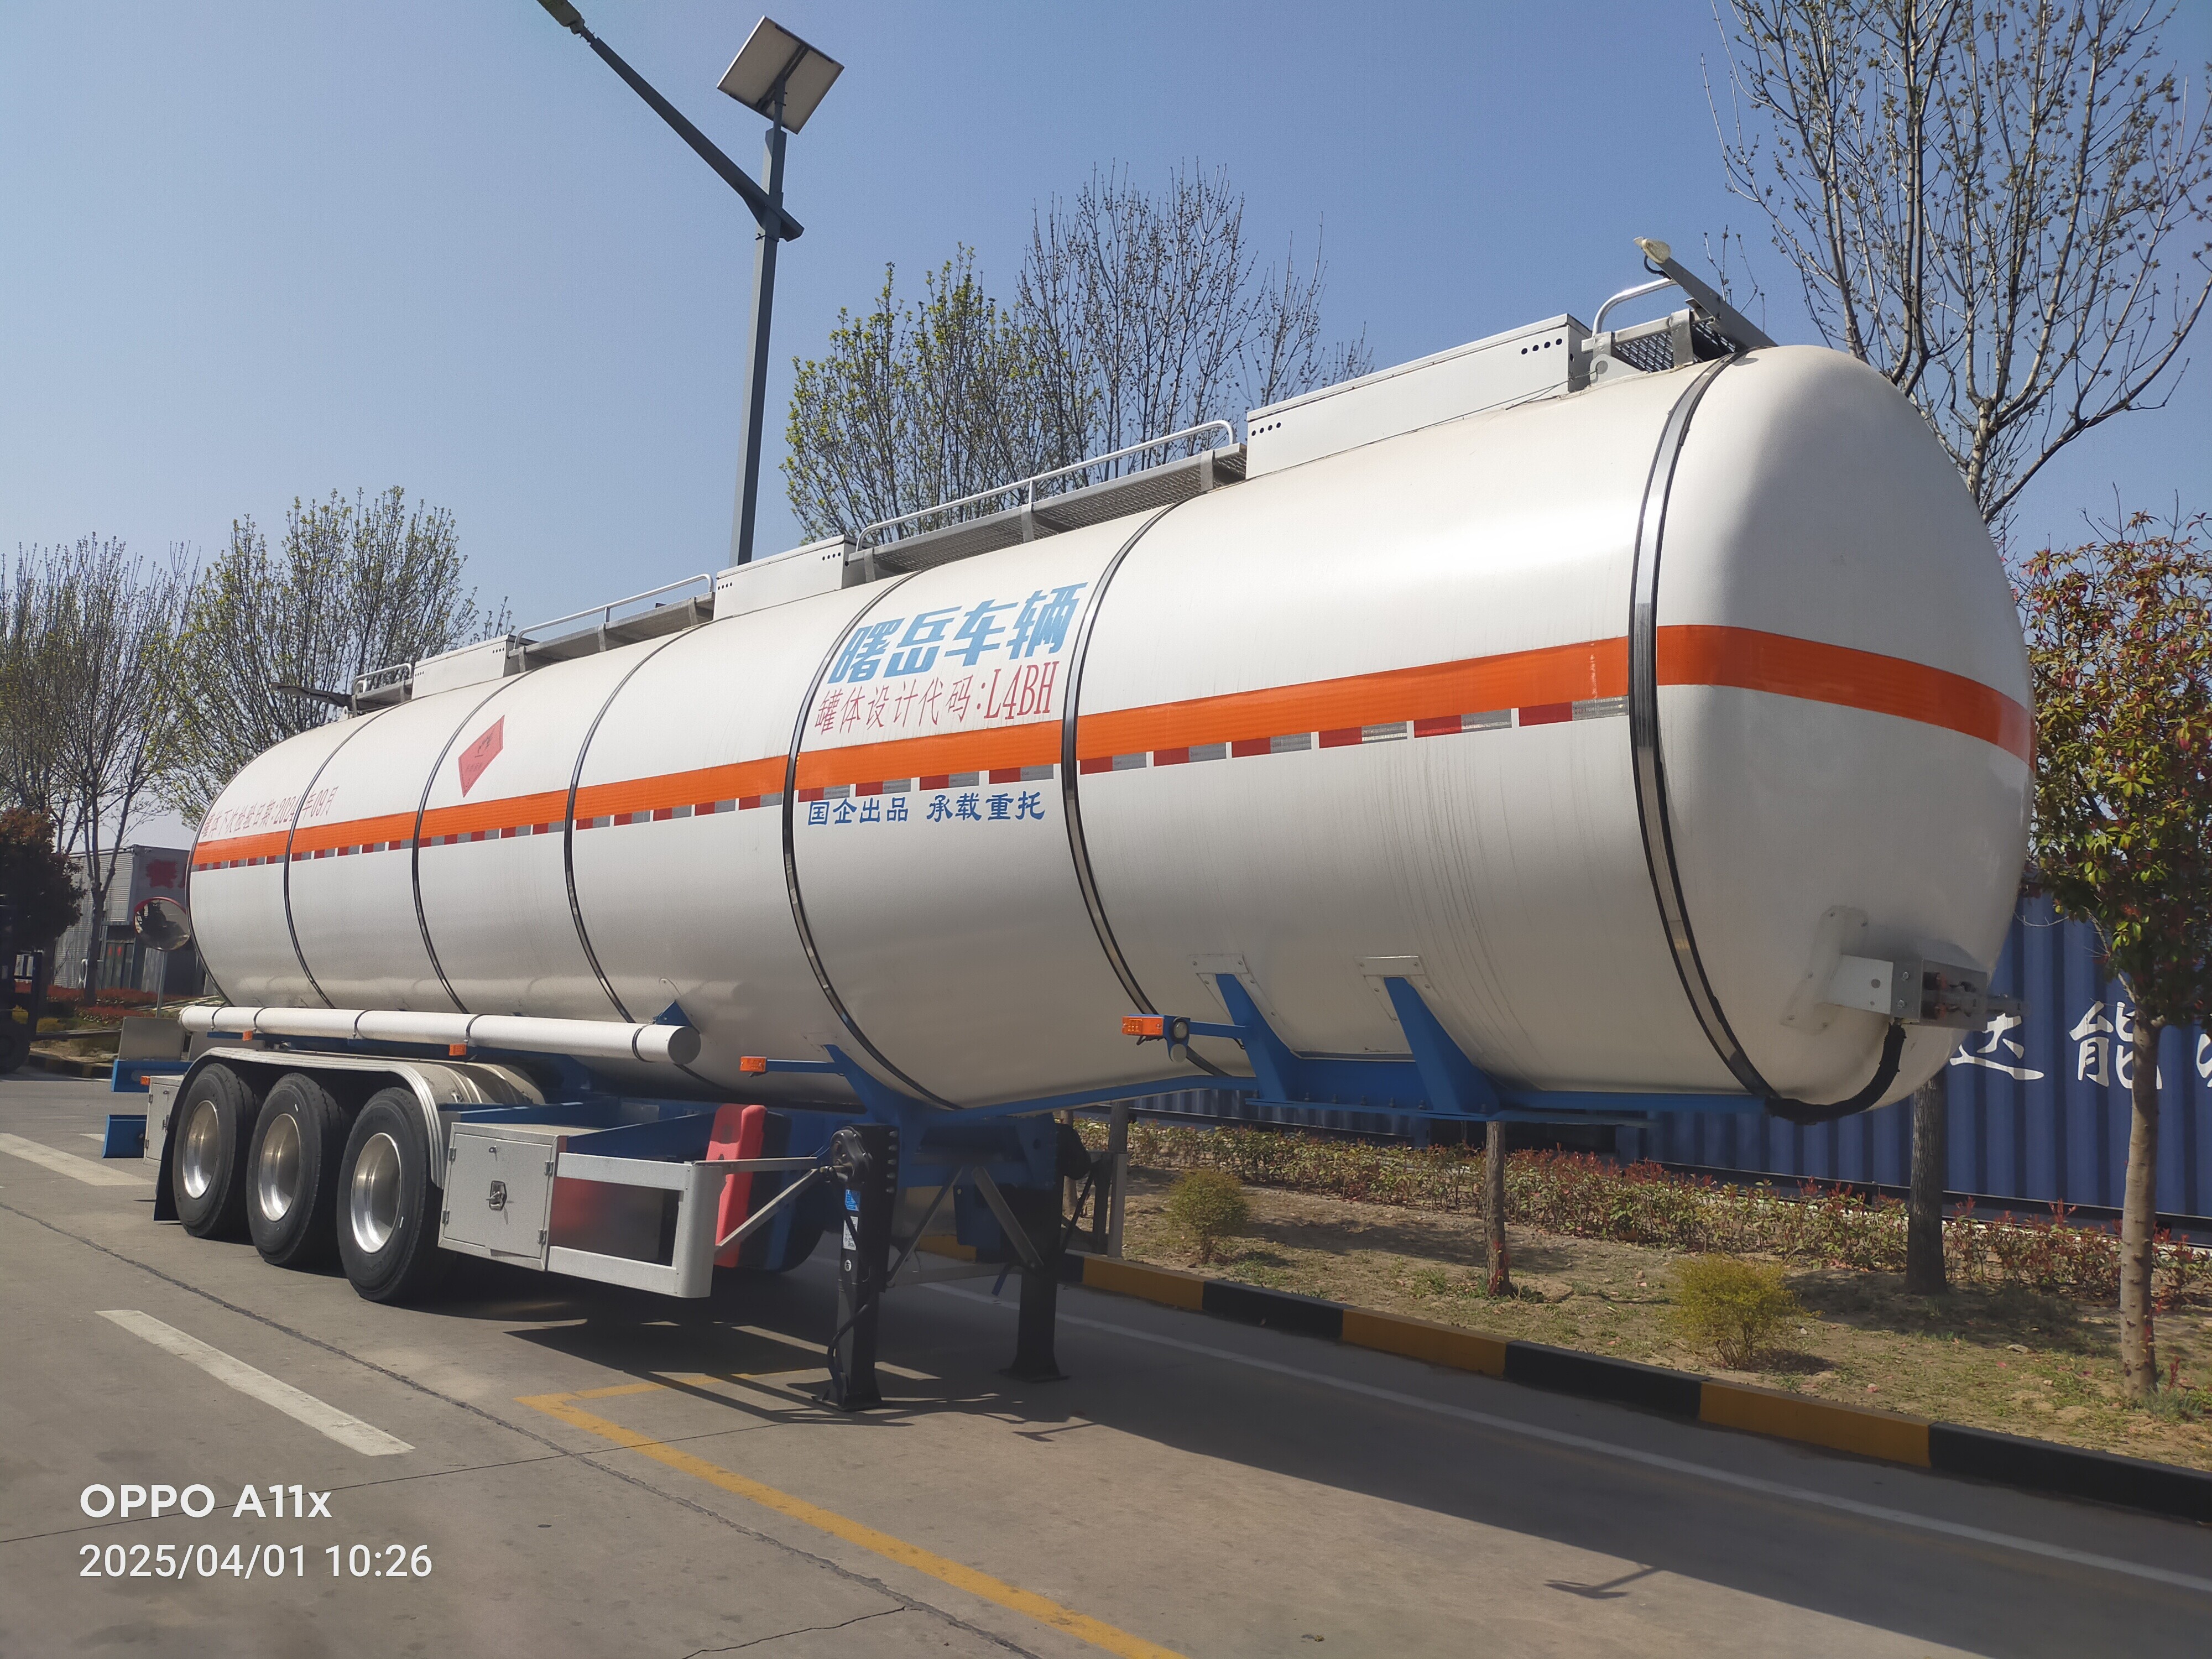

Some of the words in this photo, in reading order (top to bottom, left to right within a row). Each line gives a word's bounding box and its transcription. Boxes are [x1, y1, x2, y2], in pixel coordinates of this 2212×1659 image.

[828, 582, 1088, 684] 曙岳车辆
[807, 797, 909, 826] 国企出品
[926, 791, 1046, 822] 承载重托
[1950, 1001, 2212, 1090] 达能
